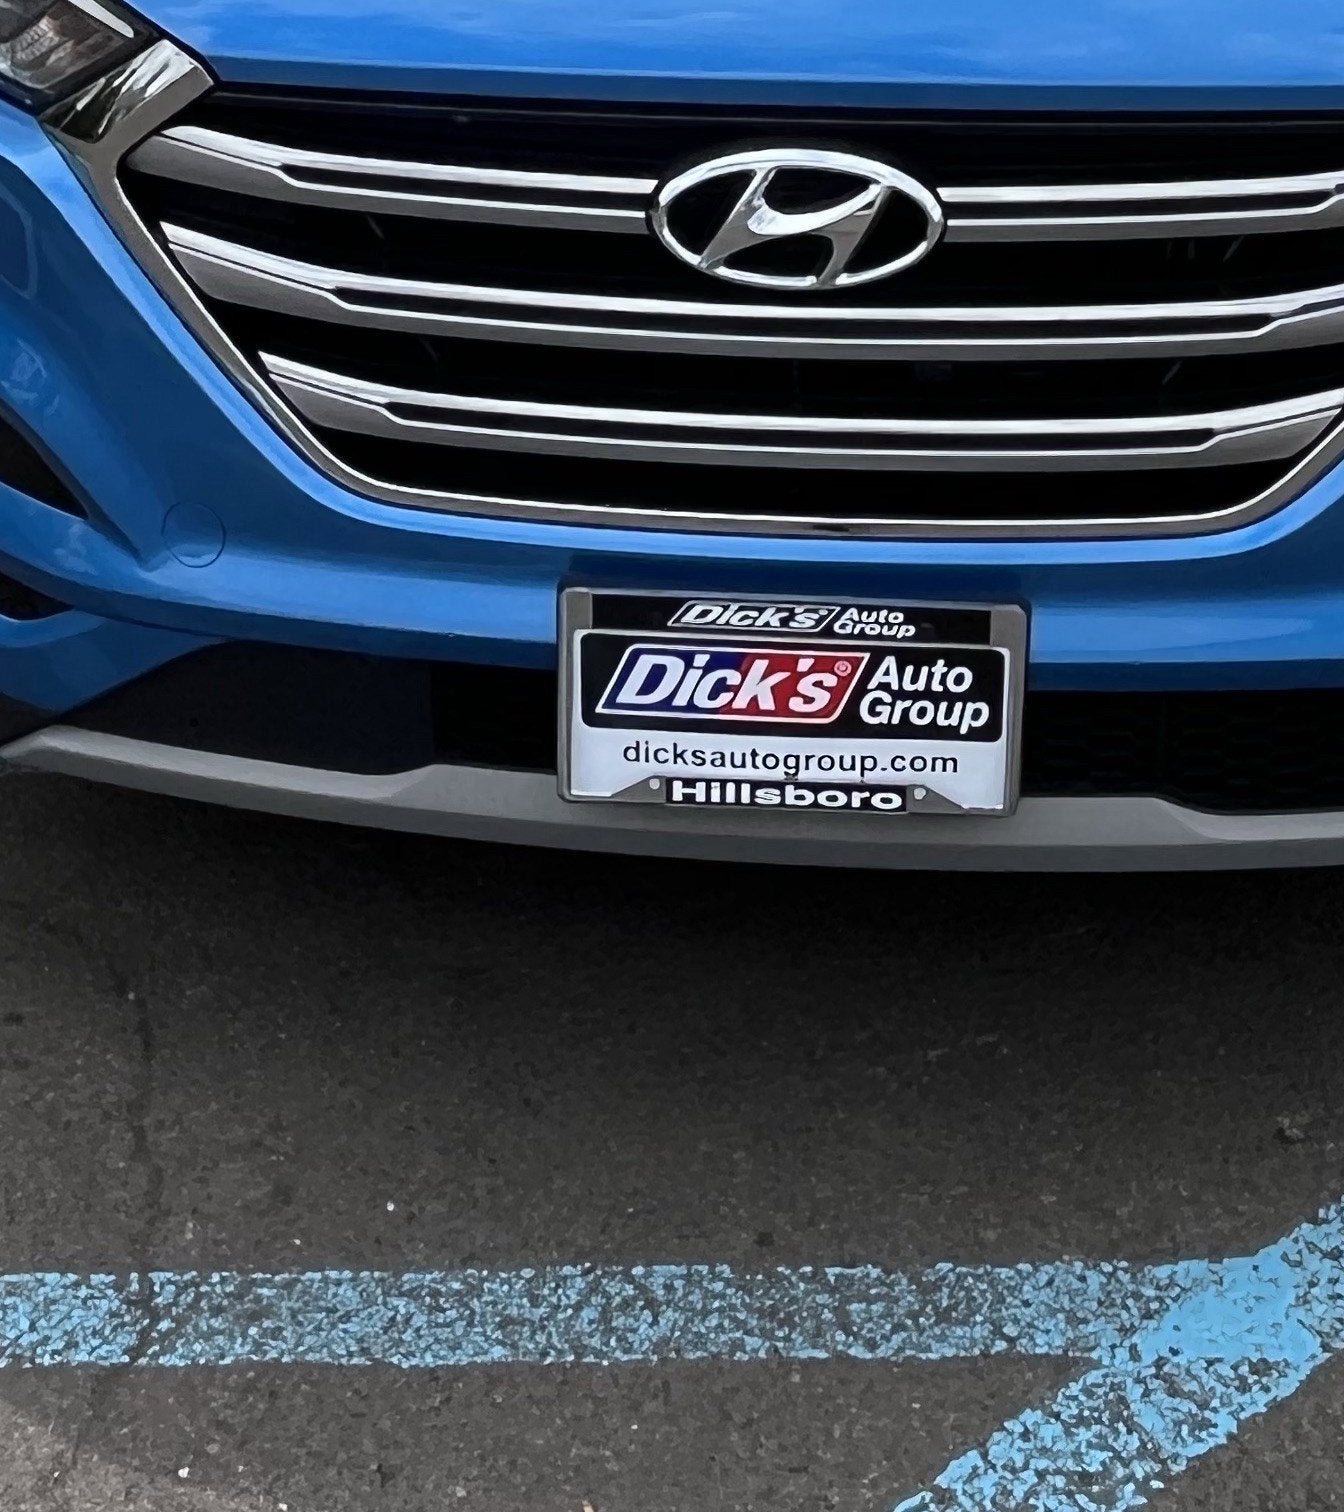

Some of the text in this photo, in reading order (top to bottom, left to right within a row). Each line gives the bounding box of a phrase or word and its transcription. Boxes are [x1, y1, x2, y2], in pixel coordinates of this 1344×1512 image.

[680, 601, 821, 629] Dick's
[833, 619, 916, 639] Group
[840, 607, 905, 624] Auto
[615, 652, 840, 714] Dick's
[866, 656, 974, 693] Auto
[858, 690, 991, 735] Group
[622, 740, 959, 775] dicksautogroup.com
[671, 779, 904, 810] Hillsboro
